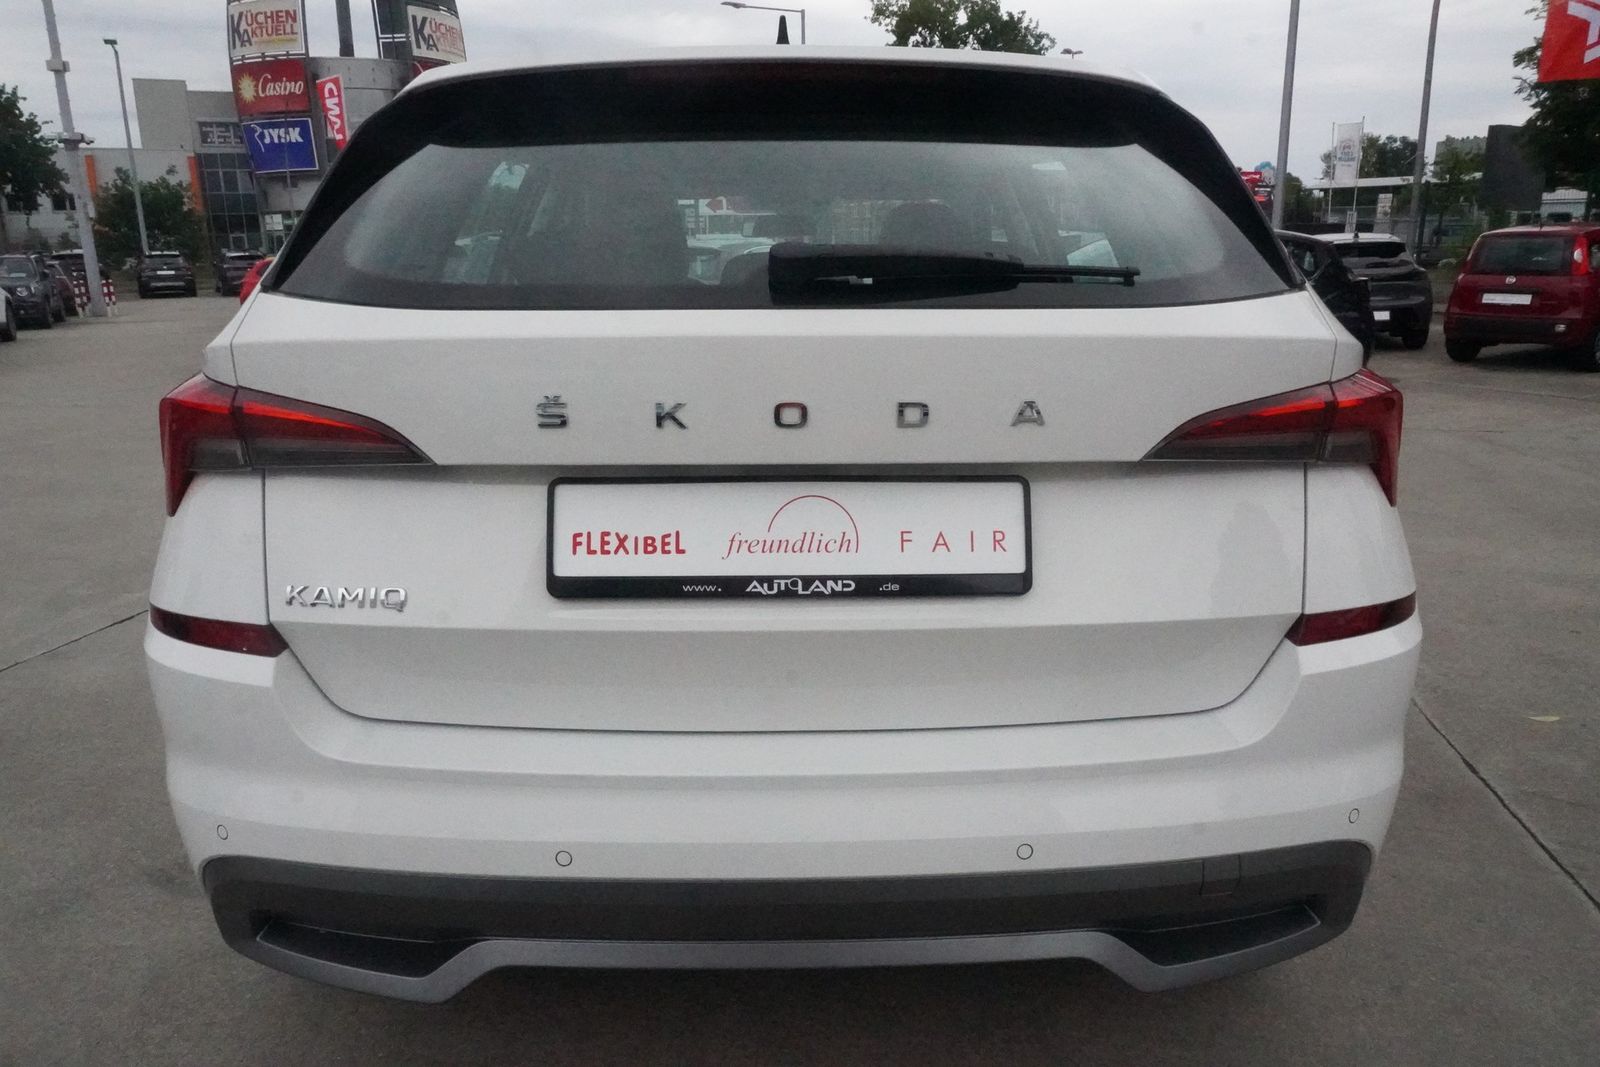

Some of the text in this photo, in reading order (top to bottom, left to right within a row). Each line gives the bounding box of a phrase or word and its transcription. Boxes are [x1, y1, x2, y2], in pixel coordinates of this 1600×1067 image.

[259, 73, 304, 97] Casino
[263, 127, 304, 144] JYSK
[572, 530, 1007, 559] FLEXIBEL freundlich FAIR
[285, 584, 408, 612] KAMIQ
[745, 577, 856, 596] AUTOLAND
